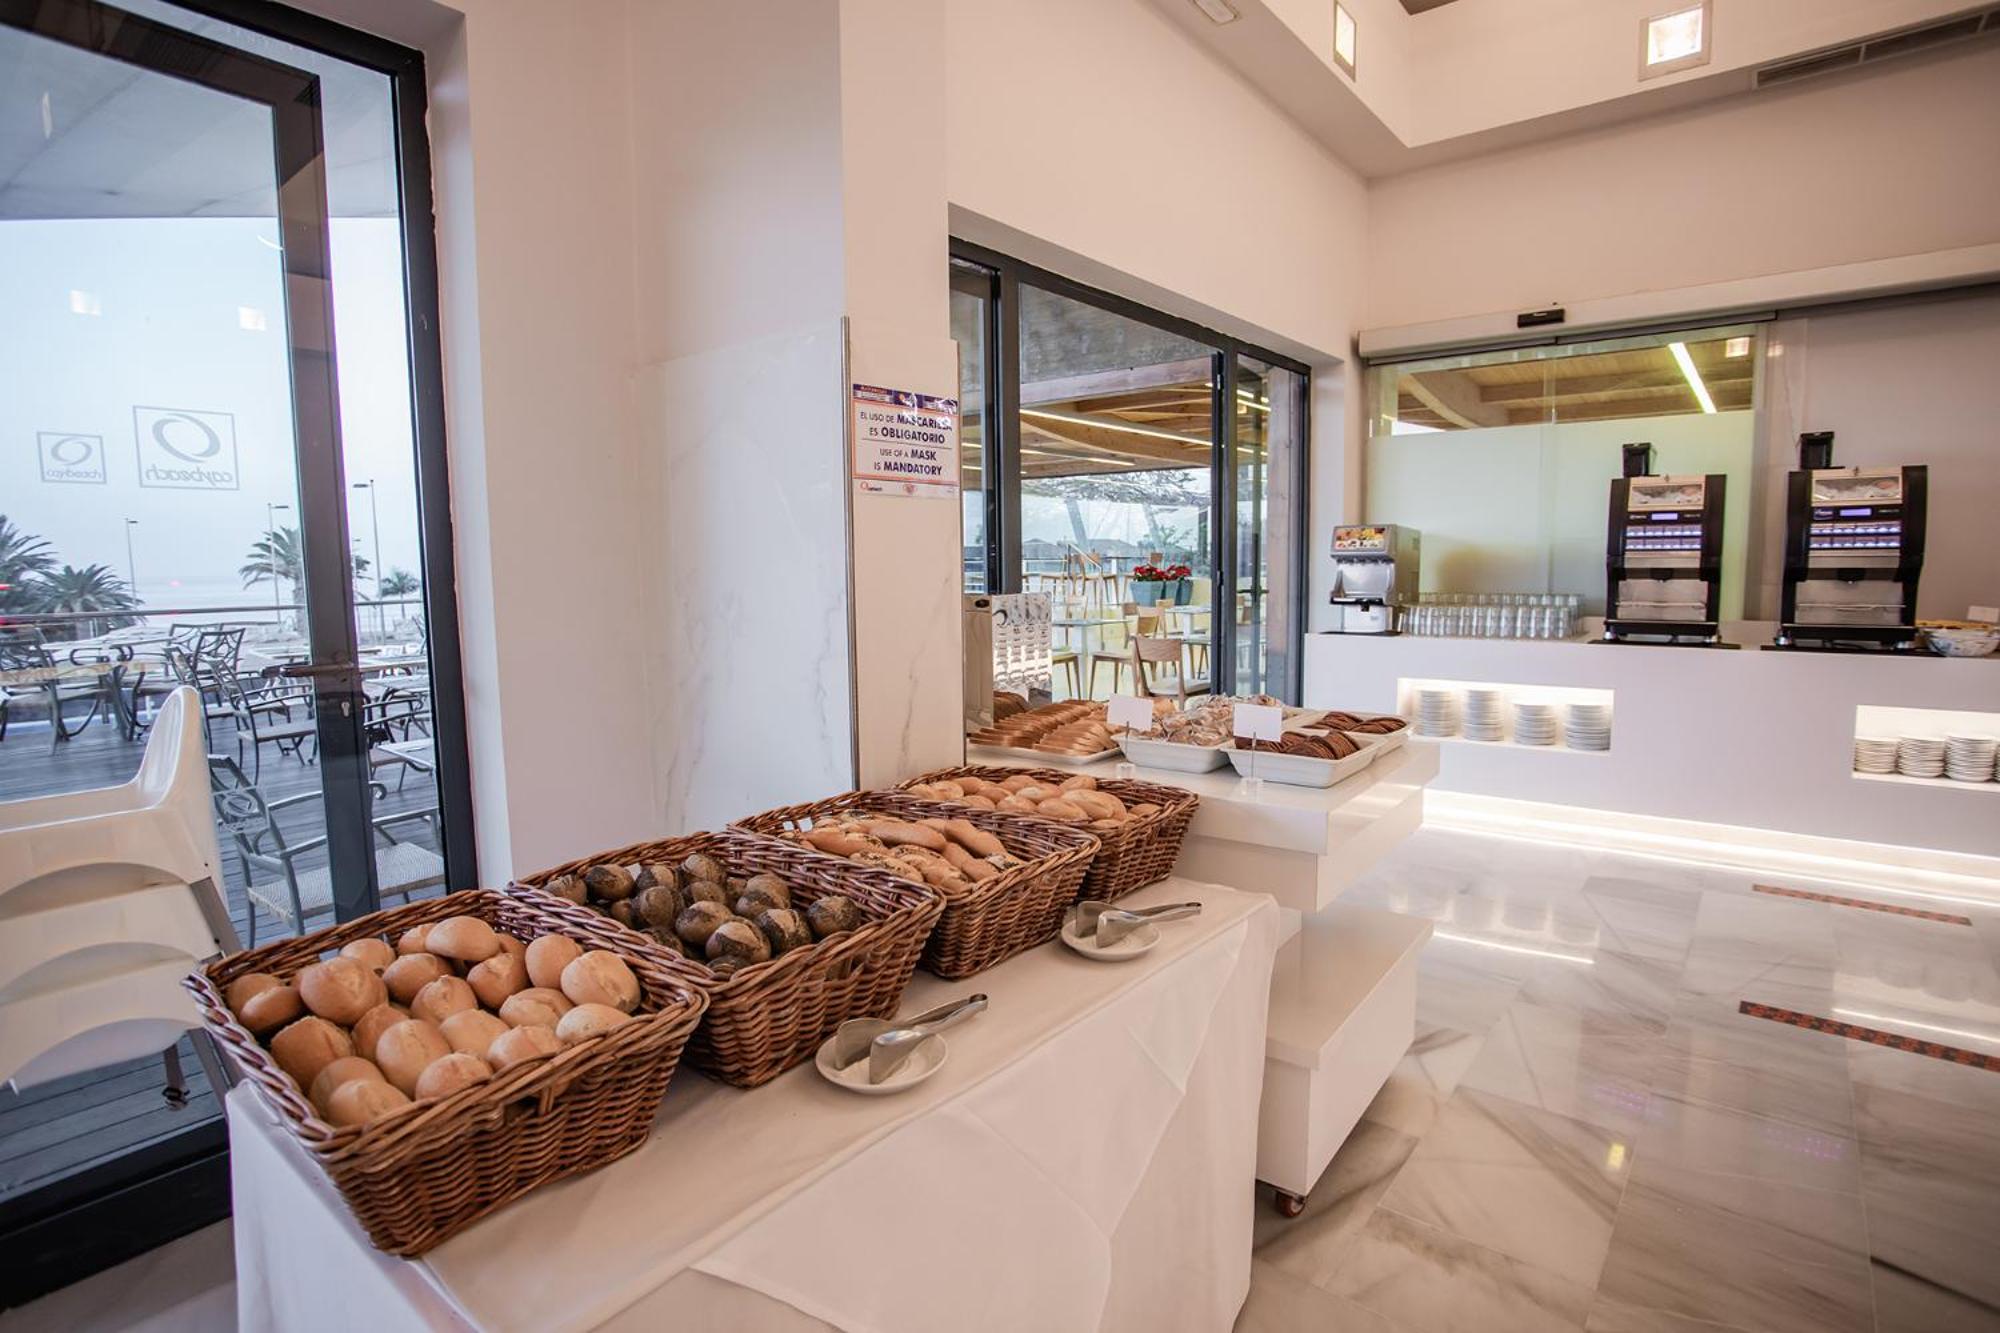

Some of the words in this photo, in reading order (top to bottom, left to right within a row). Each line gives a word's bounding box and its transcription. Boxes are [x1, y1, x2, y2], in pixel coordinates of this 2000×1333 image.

[860, 411, 867, 420] EL
[869, 412, 884, 422] USO
[886, 415, 895, 424] DE
[869, 427, 879, 437] ES
[881, 427, 945, 443] OBLIGATORIO
[879, 448, 893, 457] USE
[894, 449, 904, 458] OF
[910, 450, 937, 461] MASK
[873, 461, 881, 471] IS
[884, 461, 942, 475] MANDATORY
